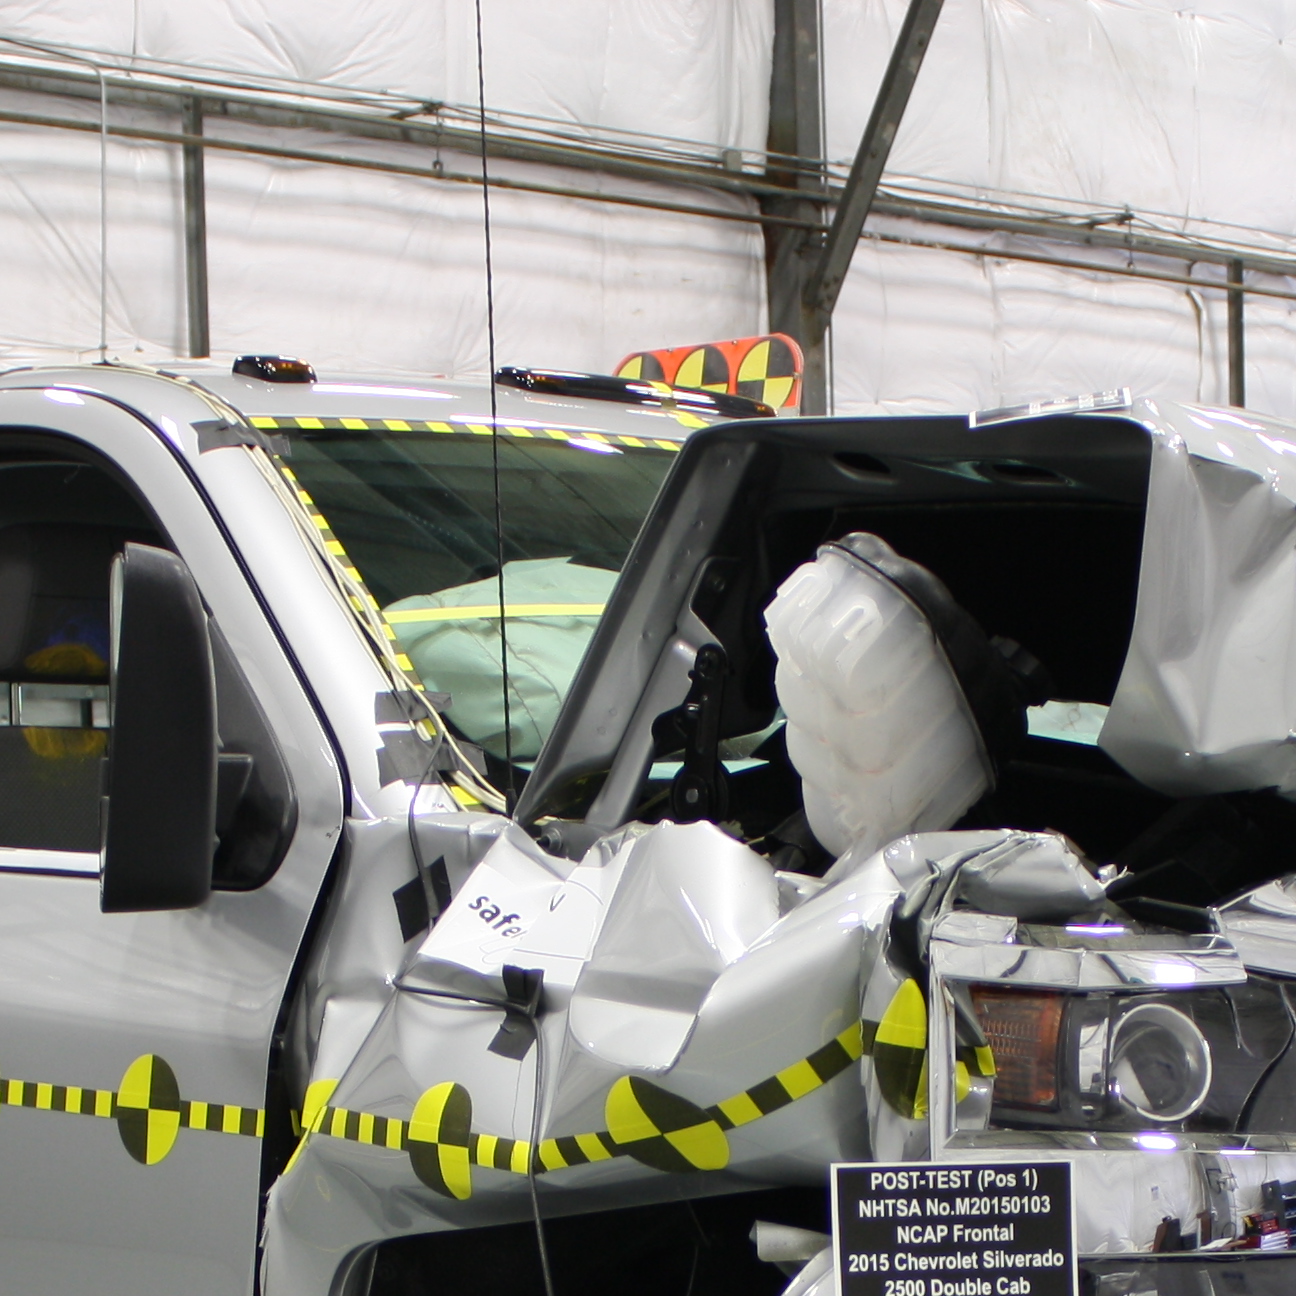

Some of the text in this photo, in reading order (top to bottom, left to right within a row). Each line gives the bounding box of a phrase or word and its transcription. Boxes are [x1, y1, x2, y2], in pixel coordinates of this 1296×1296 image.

[871, 1168, 1039, 1192] POST-TEST (Pos 1)
[858, 1195, 1051, 1218] NHTSA No.M20150103
[896, 1223, 1014, 1243] NCAP Frontal
[848, 1248, 1065, 1273] 2015 Chevrolet Silverado
[996, 1276, 1031, 1296] Cab
